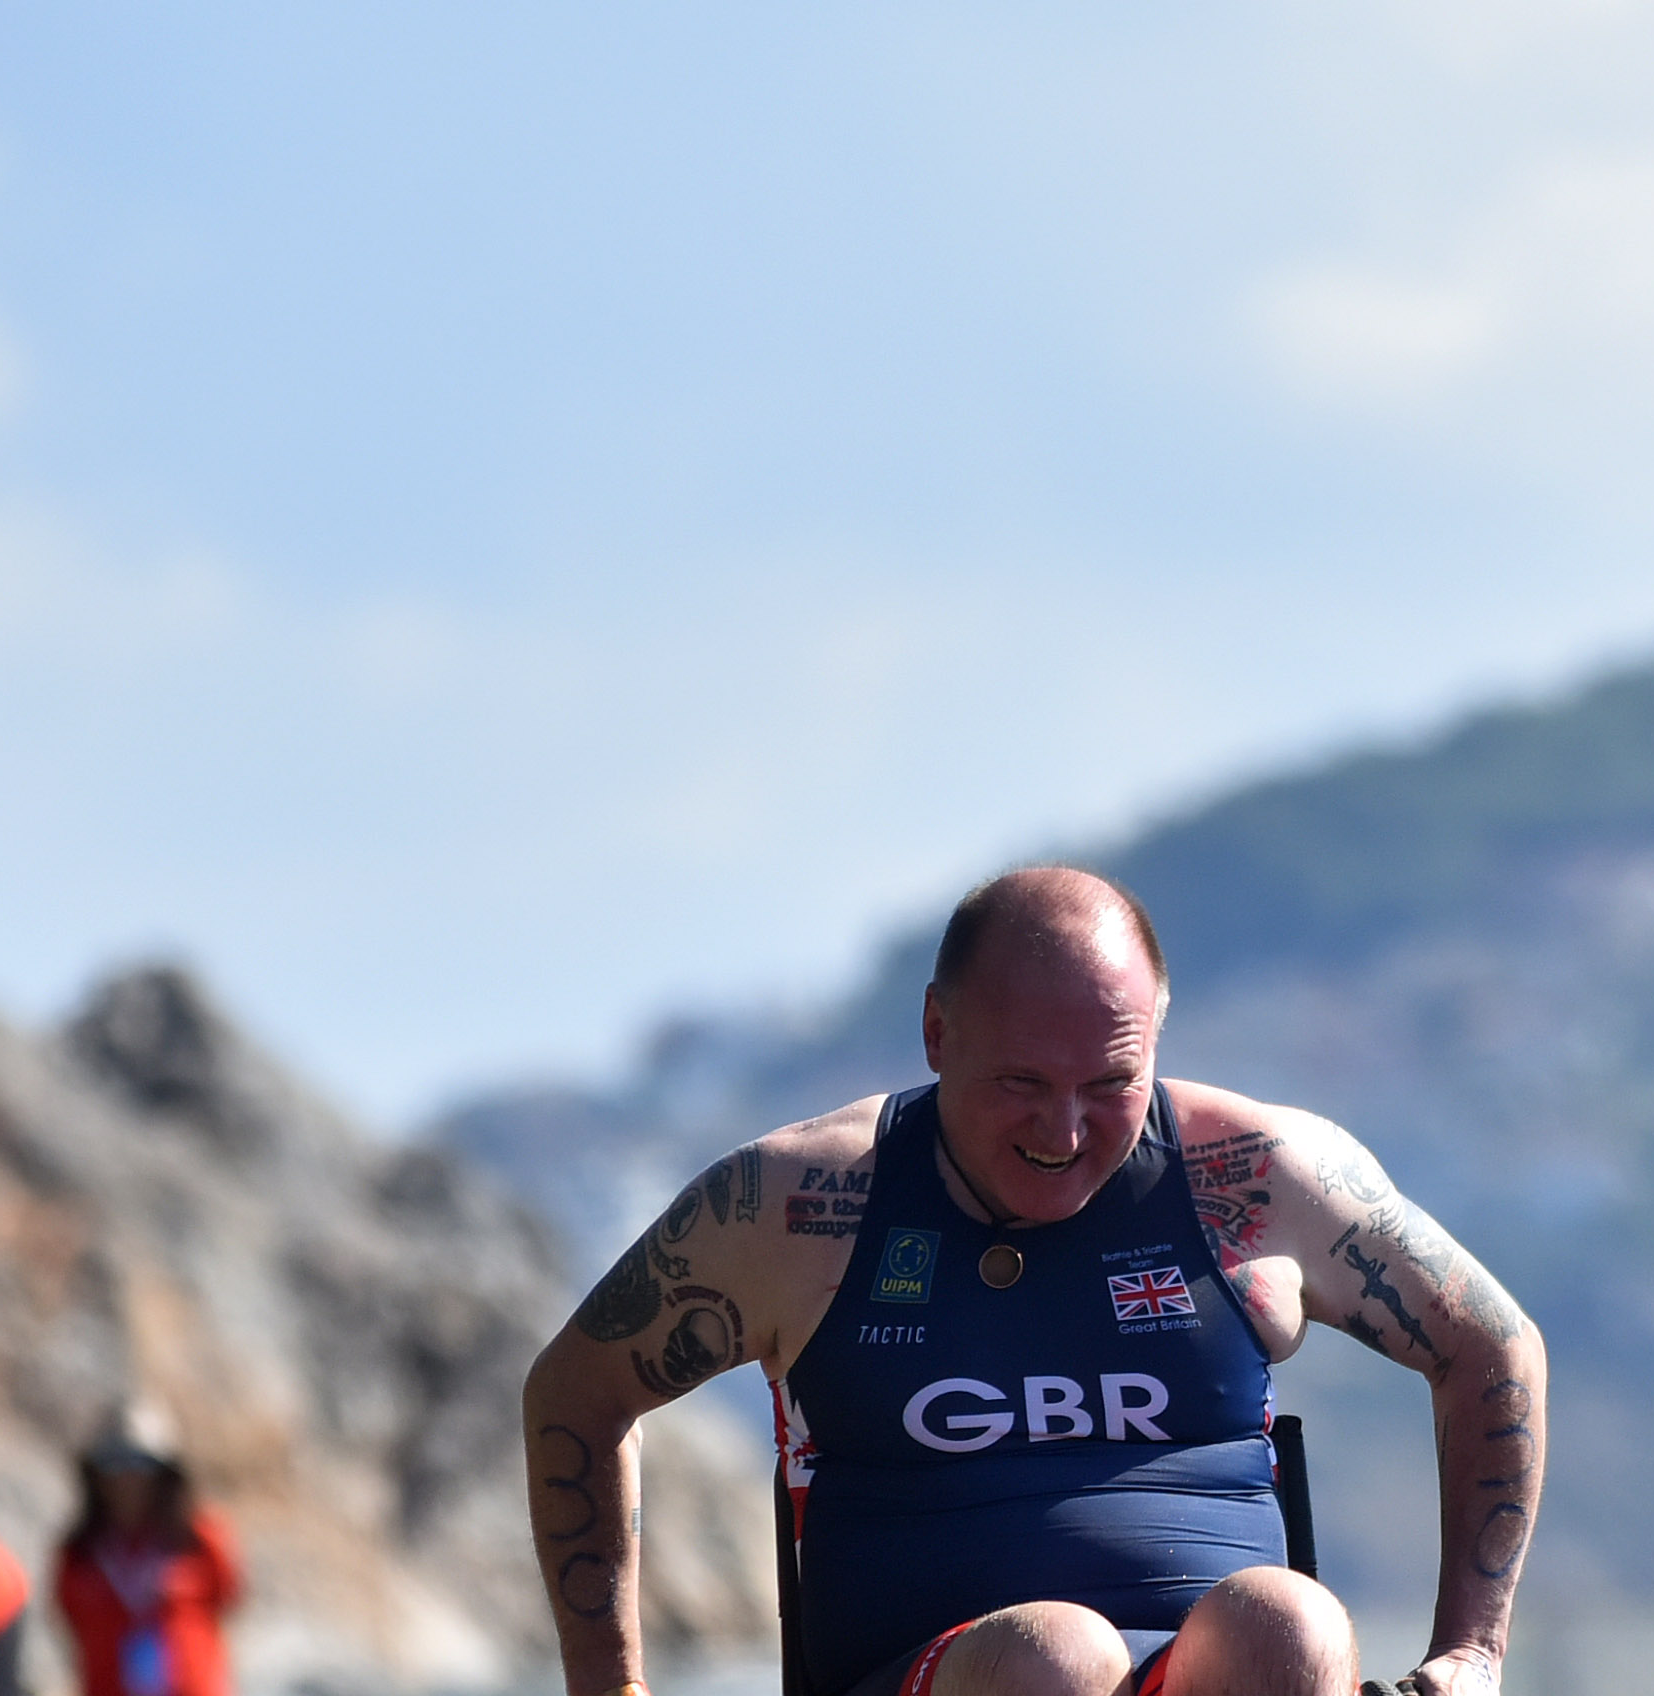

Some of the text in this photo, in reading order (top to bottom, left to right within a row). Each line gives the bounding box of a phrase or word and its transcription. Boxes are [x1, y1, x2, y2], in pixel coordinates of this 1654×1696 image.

[799, 1168, 873, 1193] FAM
[881, 1277, 922, 1294] UIPM
[858, 1325, 925, 1344] TACTIC
[1118, 1319, 1203, 1335] Great Britain
[903, 1372, 1170, 1453] GBR
